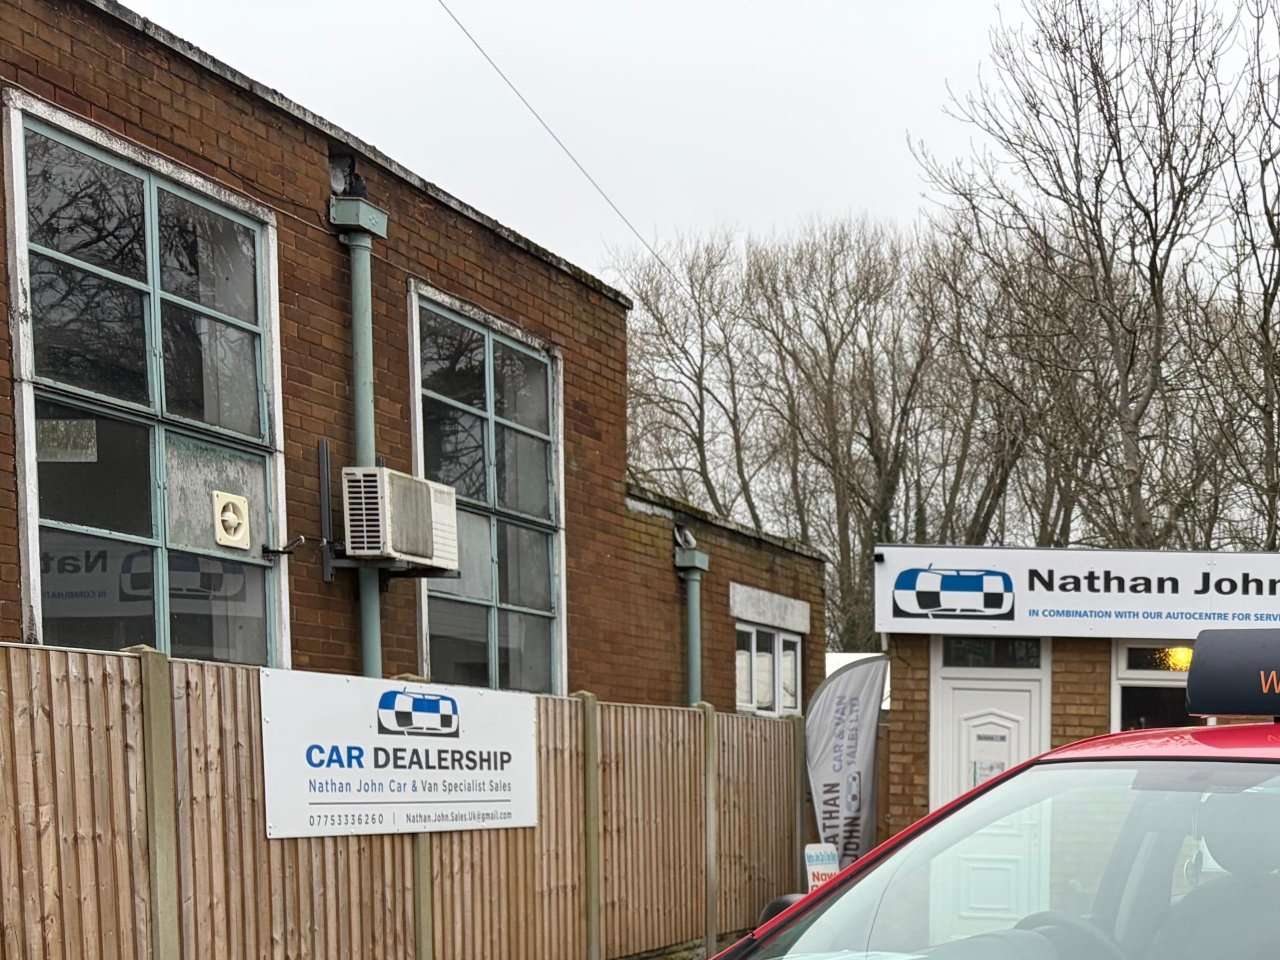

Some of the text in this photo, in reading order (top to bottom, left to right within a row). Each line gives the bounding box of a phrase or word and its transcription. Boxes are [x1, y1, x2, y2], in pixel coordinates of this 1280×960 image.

[1028, 569, 1179, 595] Nathan
[1028, 609, 1040, 617] IN
[1042, 609, 1112, 619] COMBINATION
[1114, 610, 1139, 619] WITH
[1142, 611, 1163, 620] OUR
[1165, 611, 1229, 621] AUTOCENTRE
[1232, 612, 1251, 621] FOR
[306, 744, 512, 771] CAR DEALERSHIP
[832, 744, 844, 773] CAR
[308, 779, 512, 795] Nathan John Car & Van Specialist Sales
[309, 813, 384, 827] 07753336260
[822, 782, 841, 848] ATHAN
